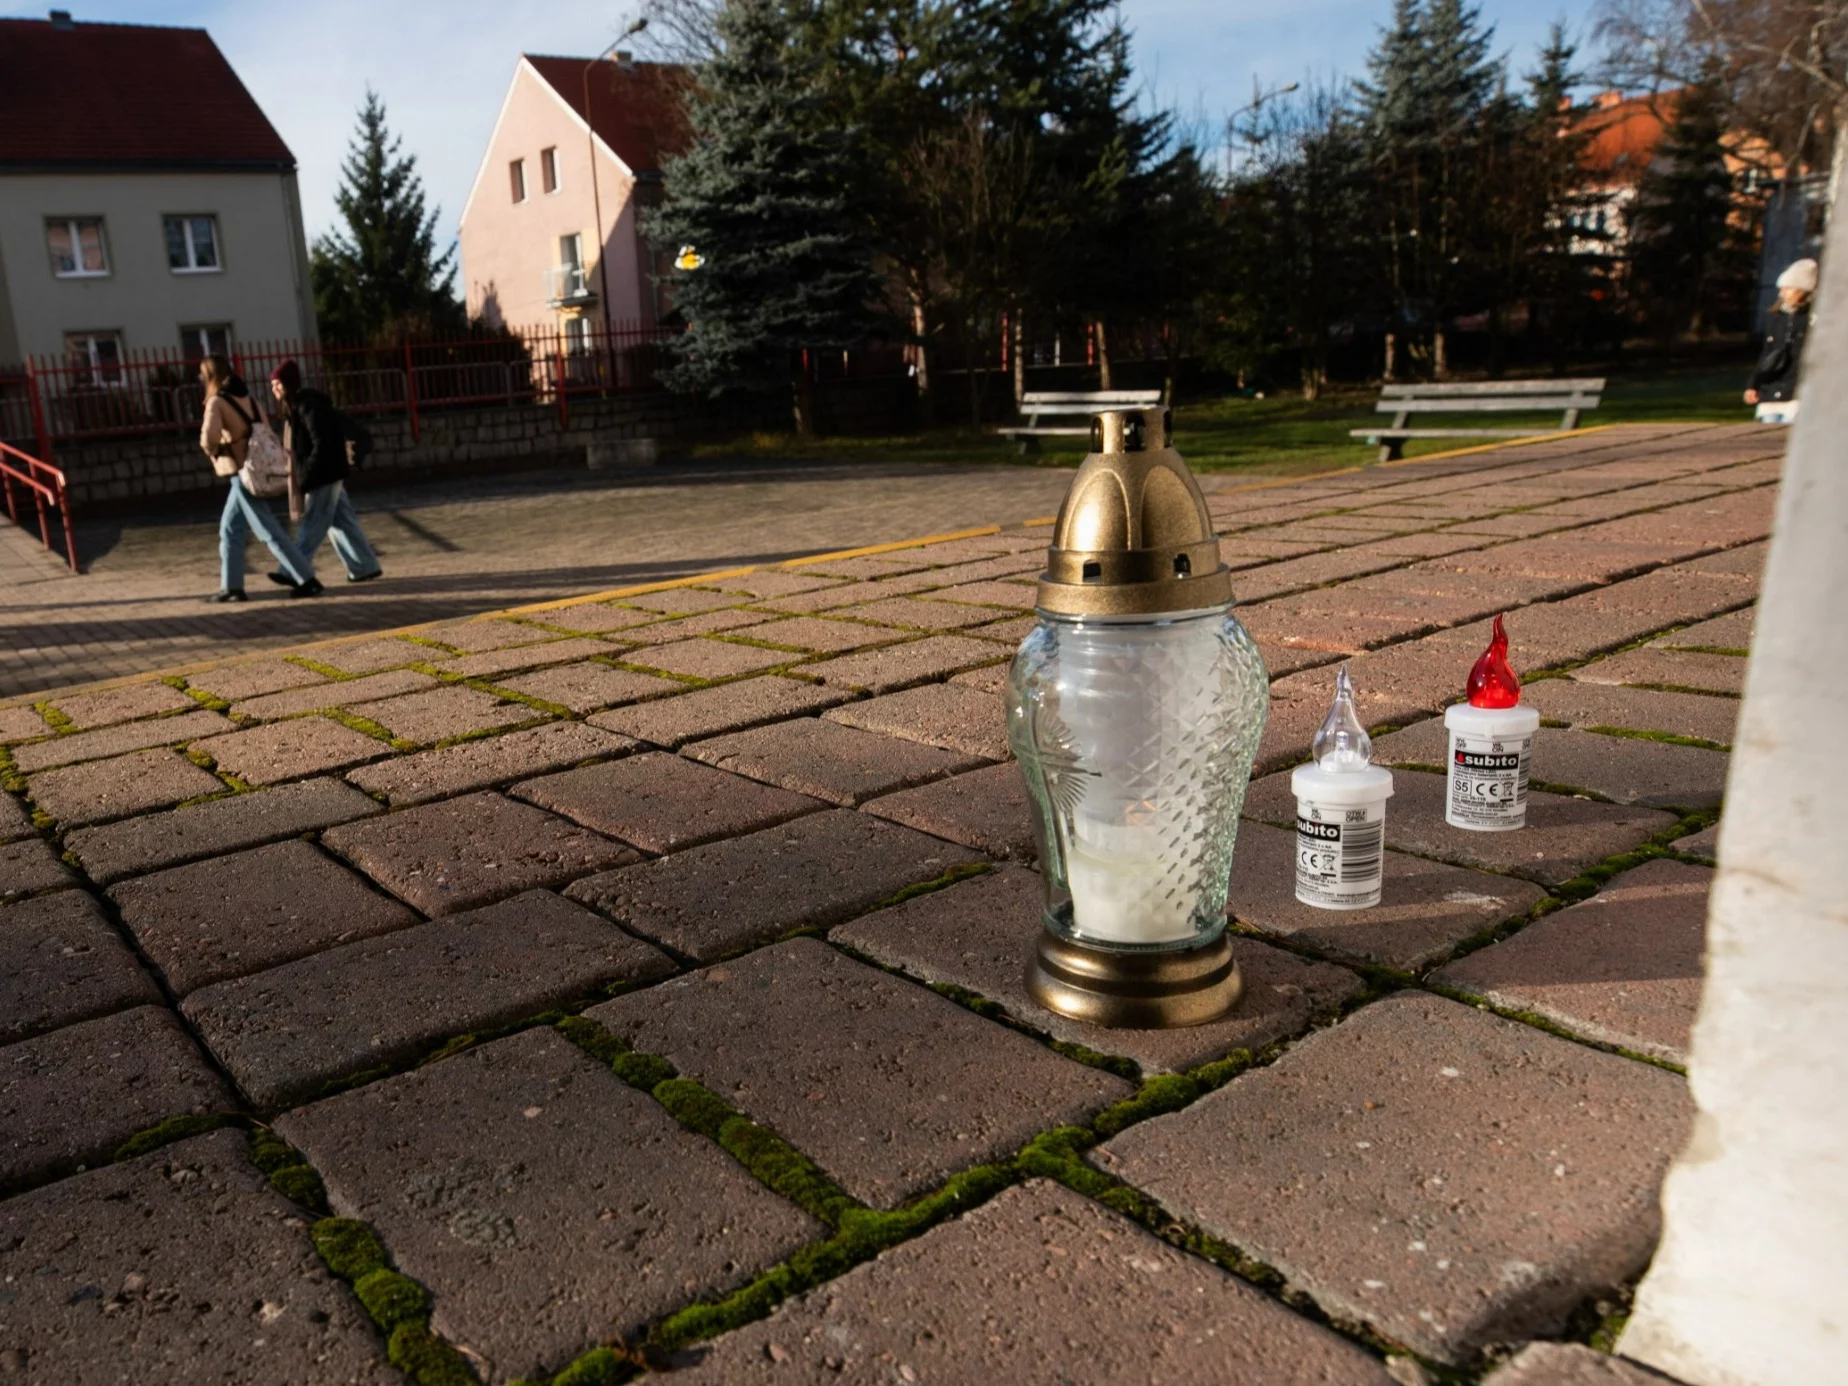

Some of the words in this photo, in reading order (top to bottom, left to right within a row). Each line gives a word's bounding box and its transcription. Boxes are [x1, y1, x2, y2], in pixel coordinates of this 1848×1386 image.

[1465, 755, 1517, 766] subito
[1455, 780, 1468, 792] S5
[1476, 783, 1498, 796] CE
[1301, 851, 1318, 868] CE
